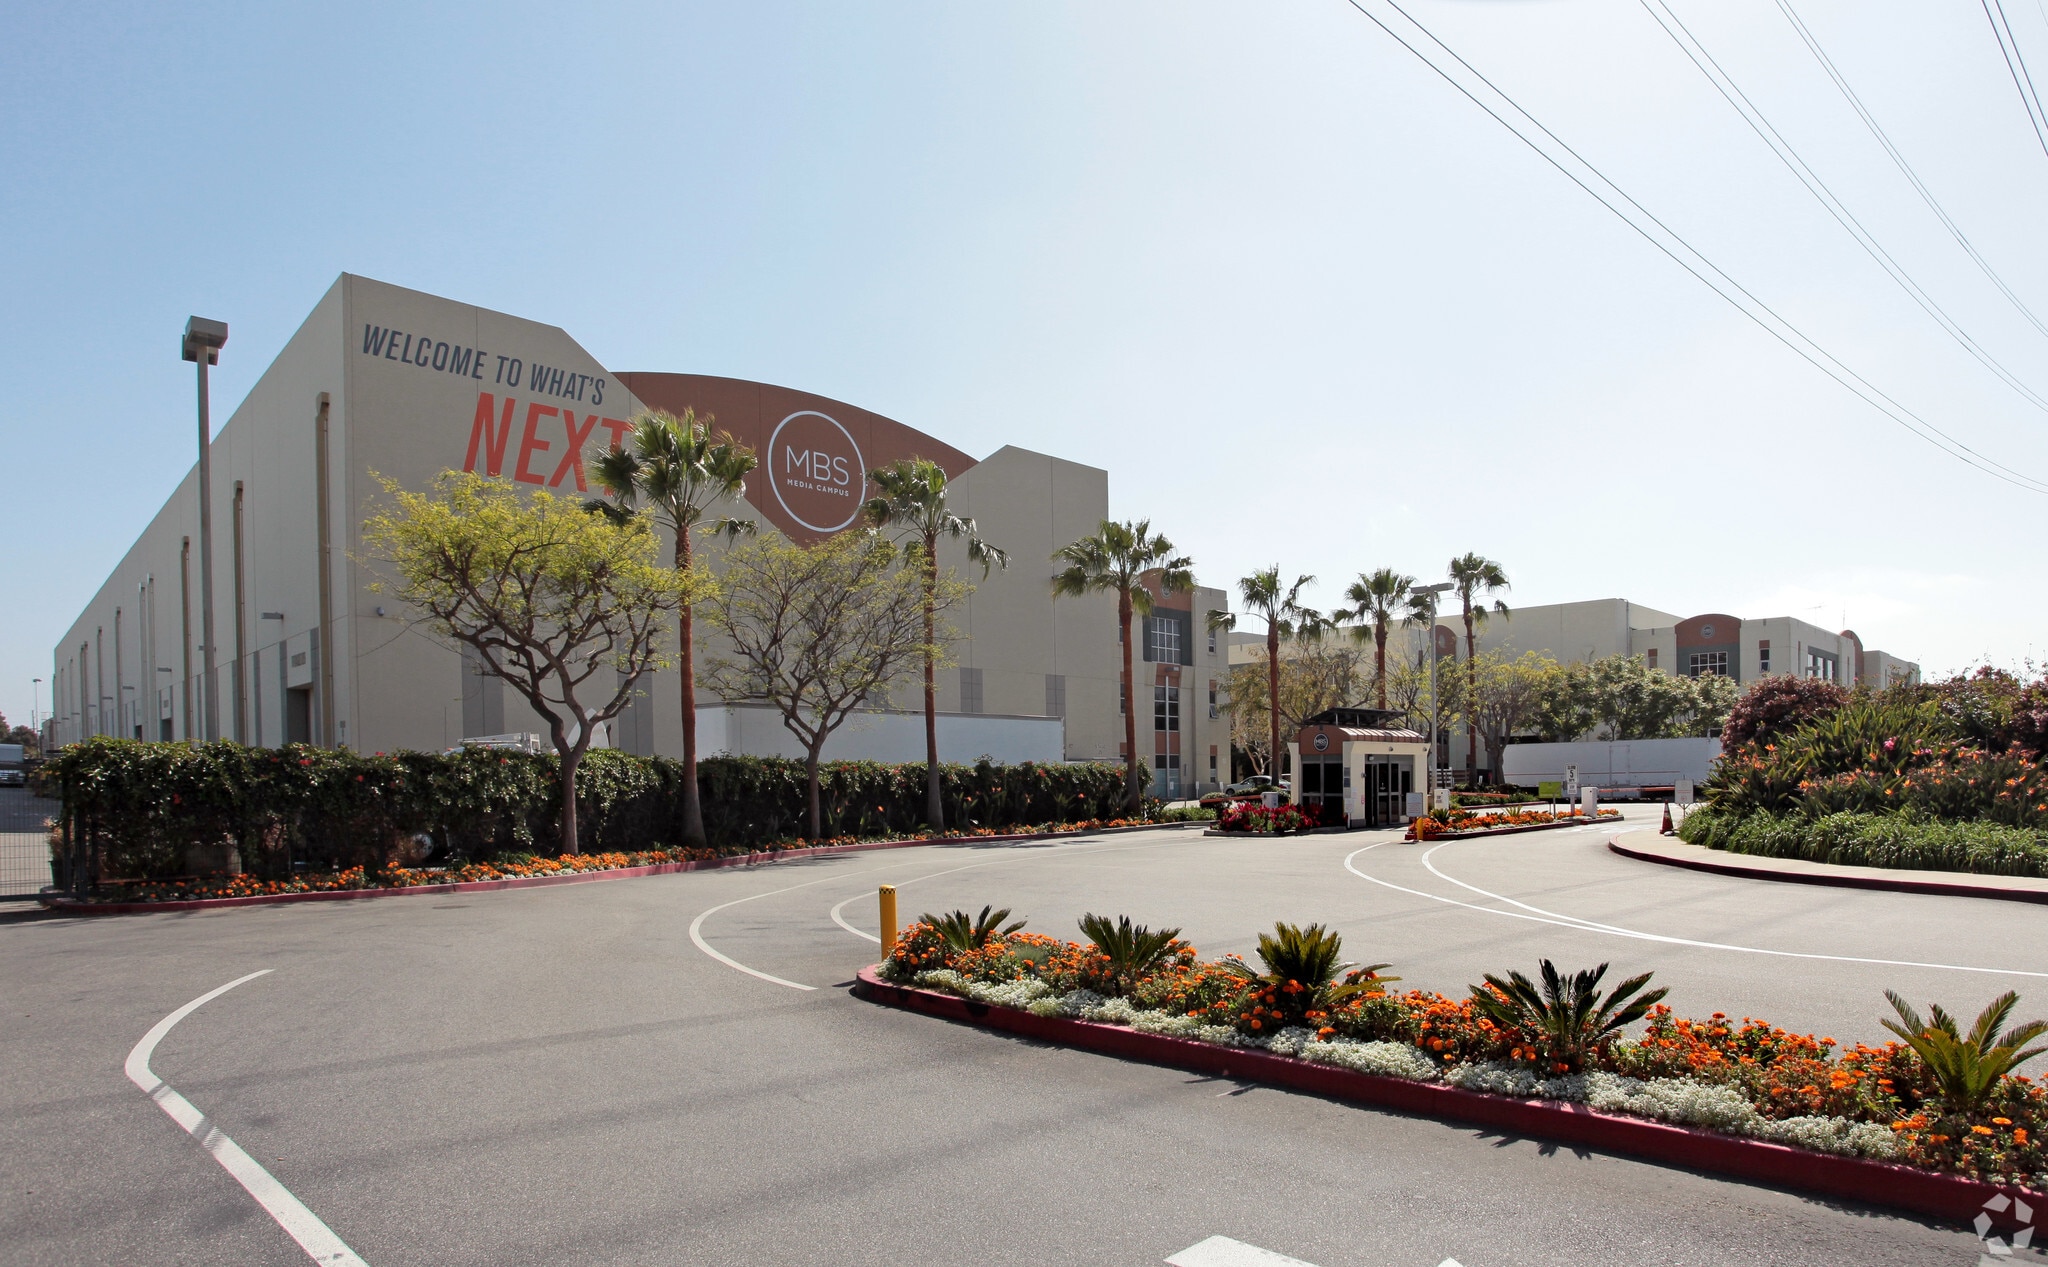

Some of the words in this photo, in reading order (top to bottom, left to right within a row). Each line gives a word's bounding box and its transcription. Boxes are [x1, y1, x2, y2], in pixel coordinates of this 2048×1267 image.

[362, 323, 488, 380] WELCOME
[495, 355, 522, 388] TO
[530, 363, 606, 406] WHAT'S
[463, 391, 637, 497] NEXT
[786, 445, 849, 485] MBS
[787, 478, 813, 489] MEDIA
[816, 484, 849, 497] CAMPUS
